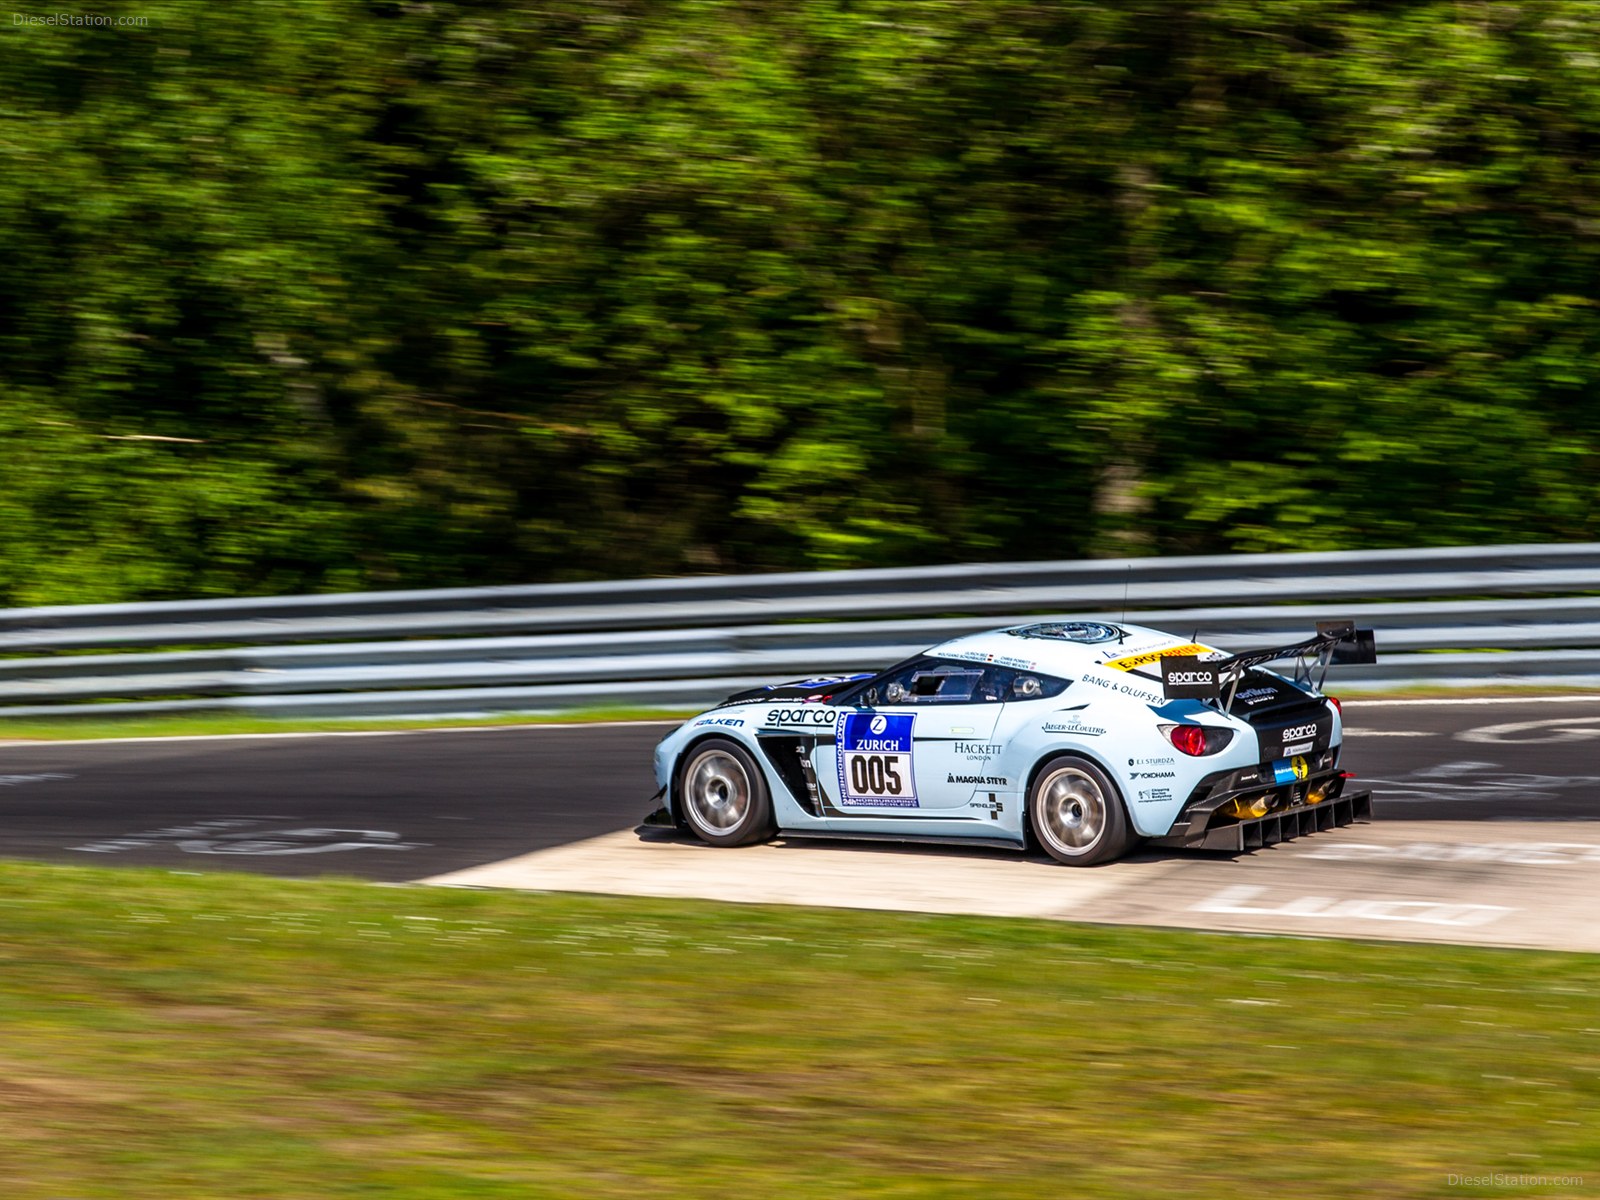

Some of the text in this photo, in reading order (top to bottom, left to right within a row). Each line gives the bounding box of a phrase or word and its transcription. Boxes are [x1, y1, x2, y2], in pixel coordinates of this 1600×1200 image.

[1168, 672, 1212, 685] sparco
[1082, 674, 1166, 706] BANG & OLUFSEN
[767, 709, 836, 727] sparco
[1282, 724, 1317, 742] sparco
[856, 739, 899, 751] ZURICH
[954, 742, 1003, 755] HACKETT
[837, 713, 848, 798] ADAC NORDRHEIN
[851, 754, 902, 795] 005
[956, 776, 1007, 786] MAGNA STEYR
